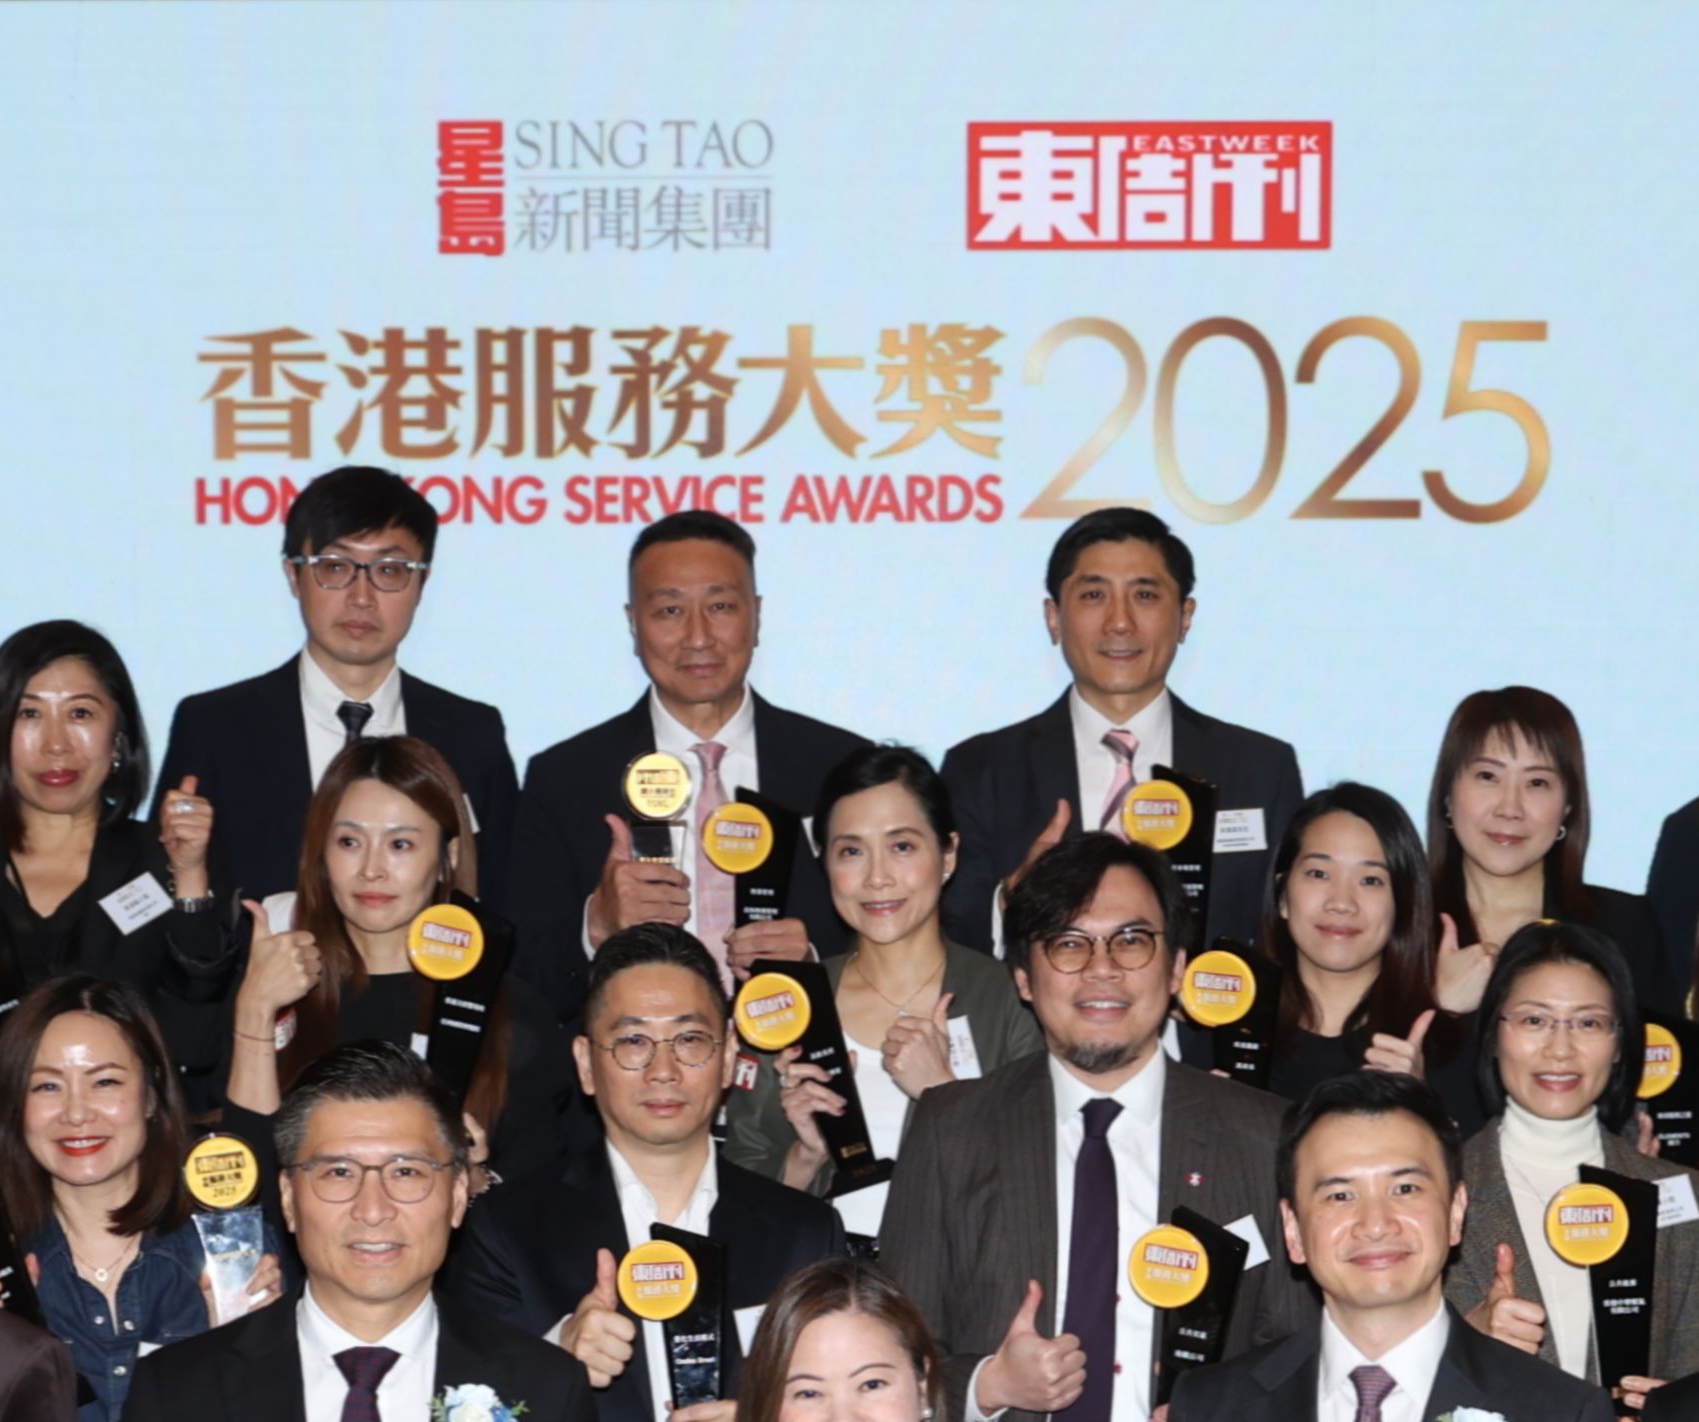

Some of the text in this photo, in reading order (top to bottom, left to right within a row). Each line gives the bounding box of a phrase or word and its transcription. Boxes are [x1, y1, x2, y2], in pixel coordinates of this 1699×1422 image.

[515, 119, 775, 169] SING TAO
[1133, 134, 1320, 152] EASTWEEK
[437, 120, 505, 256] 星島
[974, 130, 1321, 242] 東周刊
[513, 186, 772, 254] 新聞集團
[196, 315, 1551, 524] 香港服務大獎 2025
[406, 475, 548, 526] ONG
[564, 475, 764, 524] SERVICE
[779, 474, 1003, 524] AWARDS
[1560, 1206, 1614, 1224] 東周刊
[632, 1263, 685, 1282] 東周刊
[1145, 1245, 1198, 1268] 東周刊
